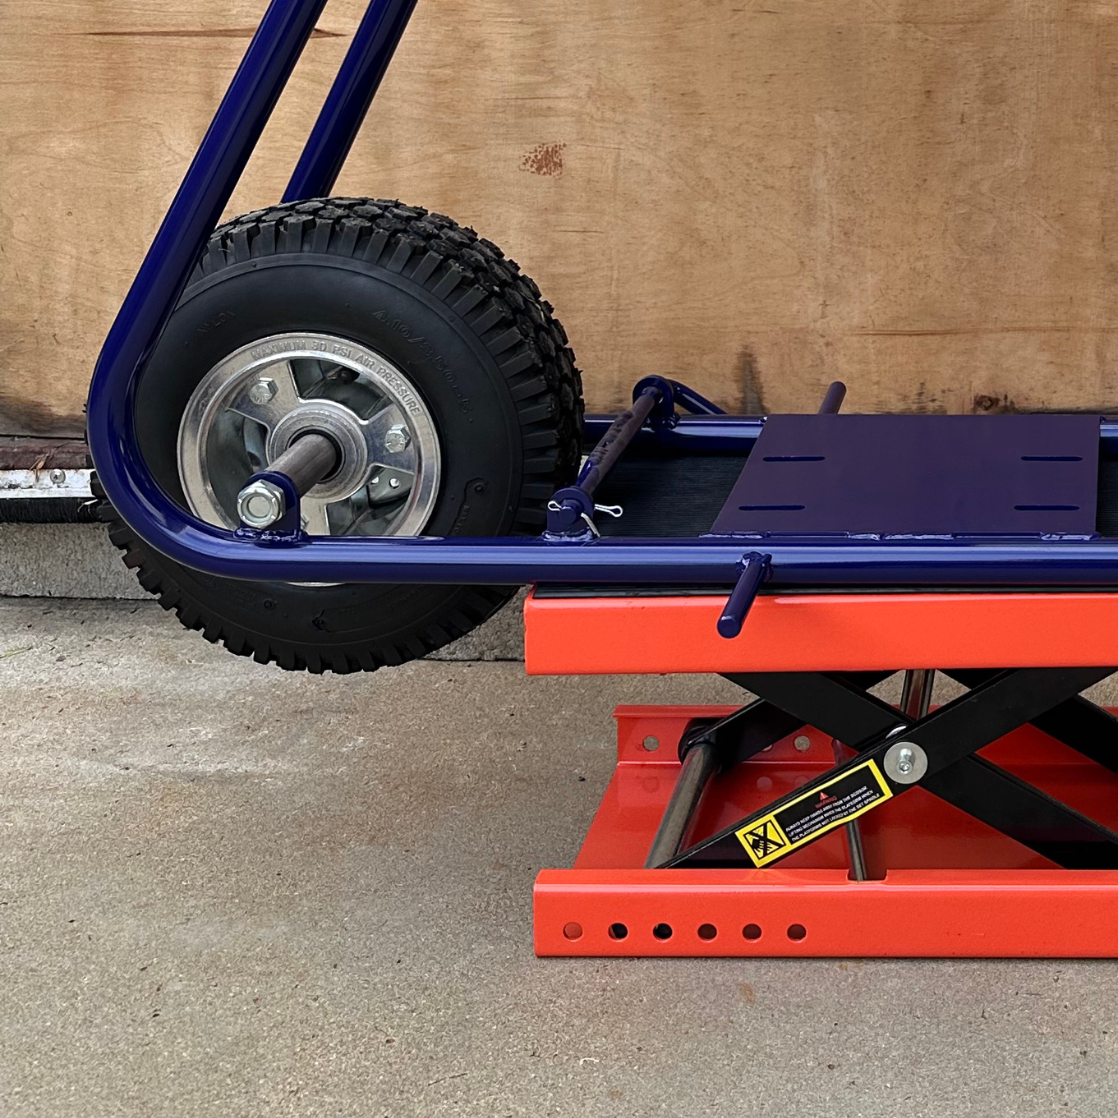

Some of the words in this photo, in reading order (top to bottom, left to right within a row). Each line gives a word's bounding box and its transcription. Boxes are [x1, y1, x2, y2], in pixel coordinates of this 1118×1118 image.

[333, 344, 352, 358] PSI
[355, 353, 376, 368] AIR
[376, 366, 422, 416] PRESSURE
